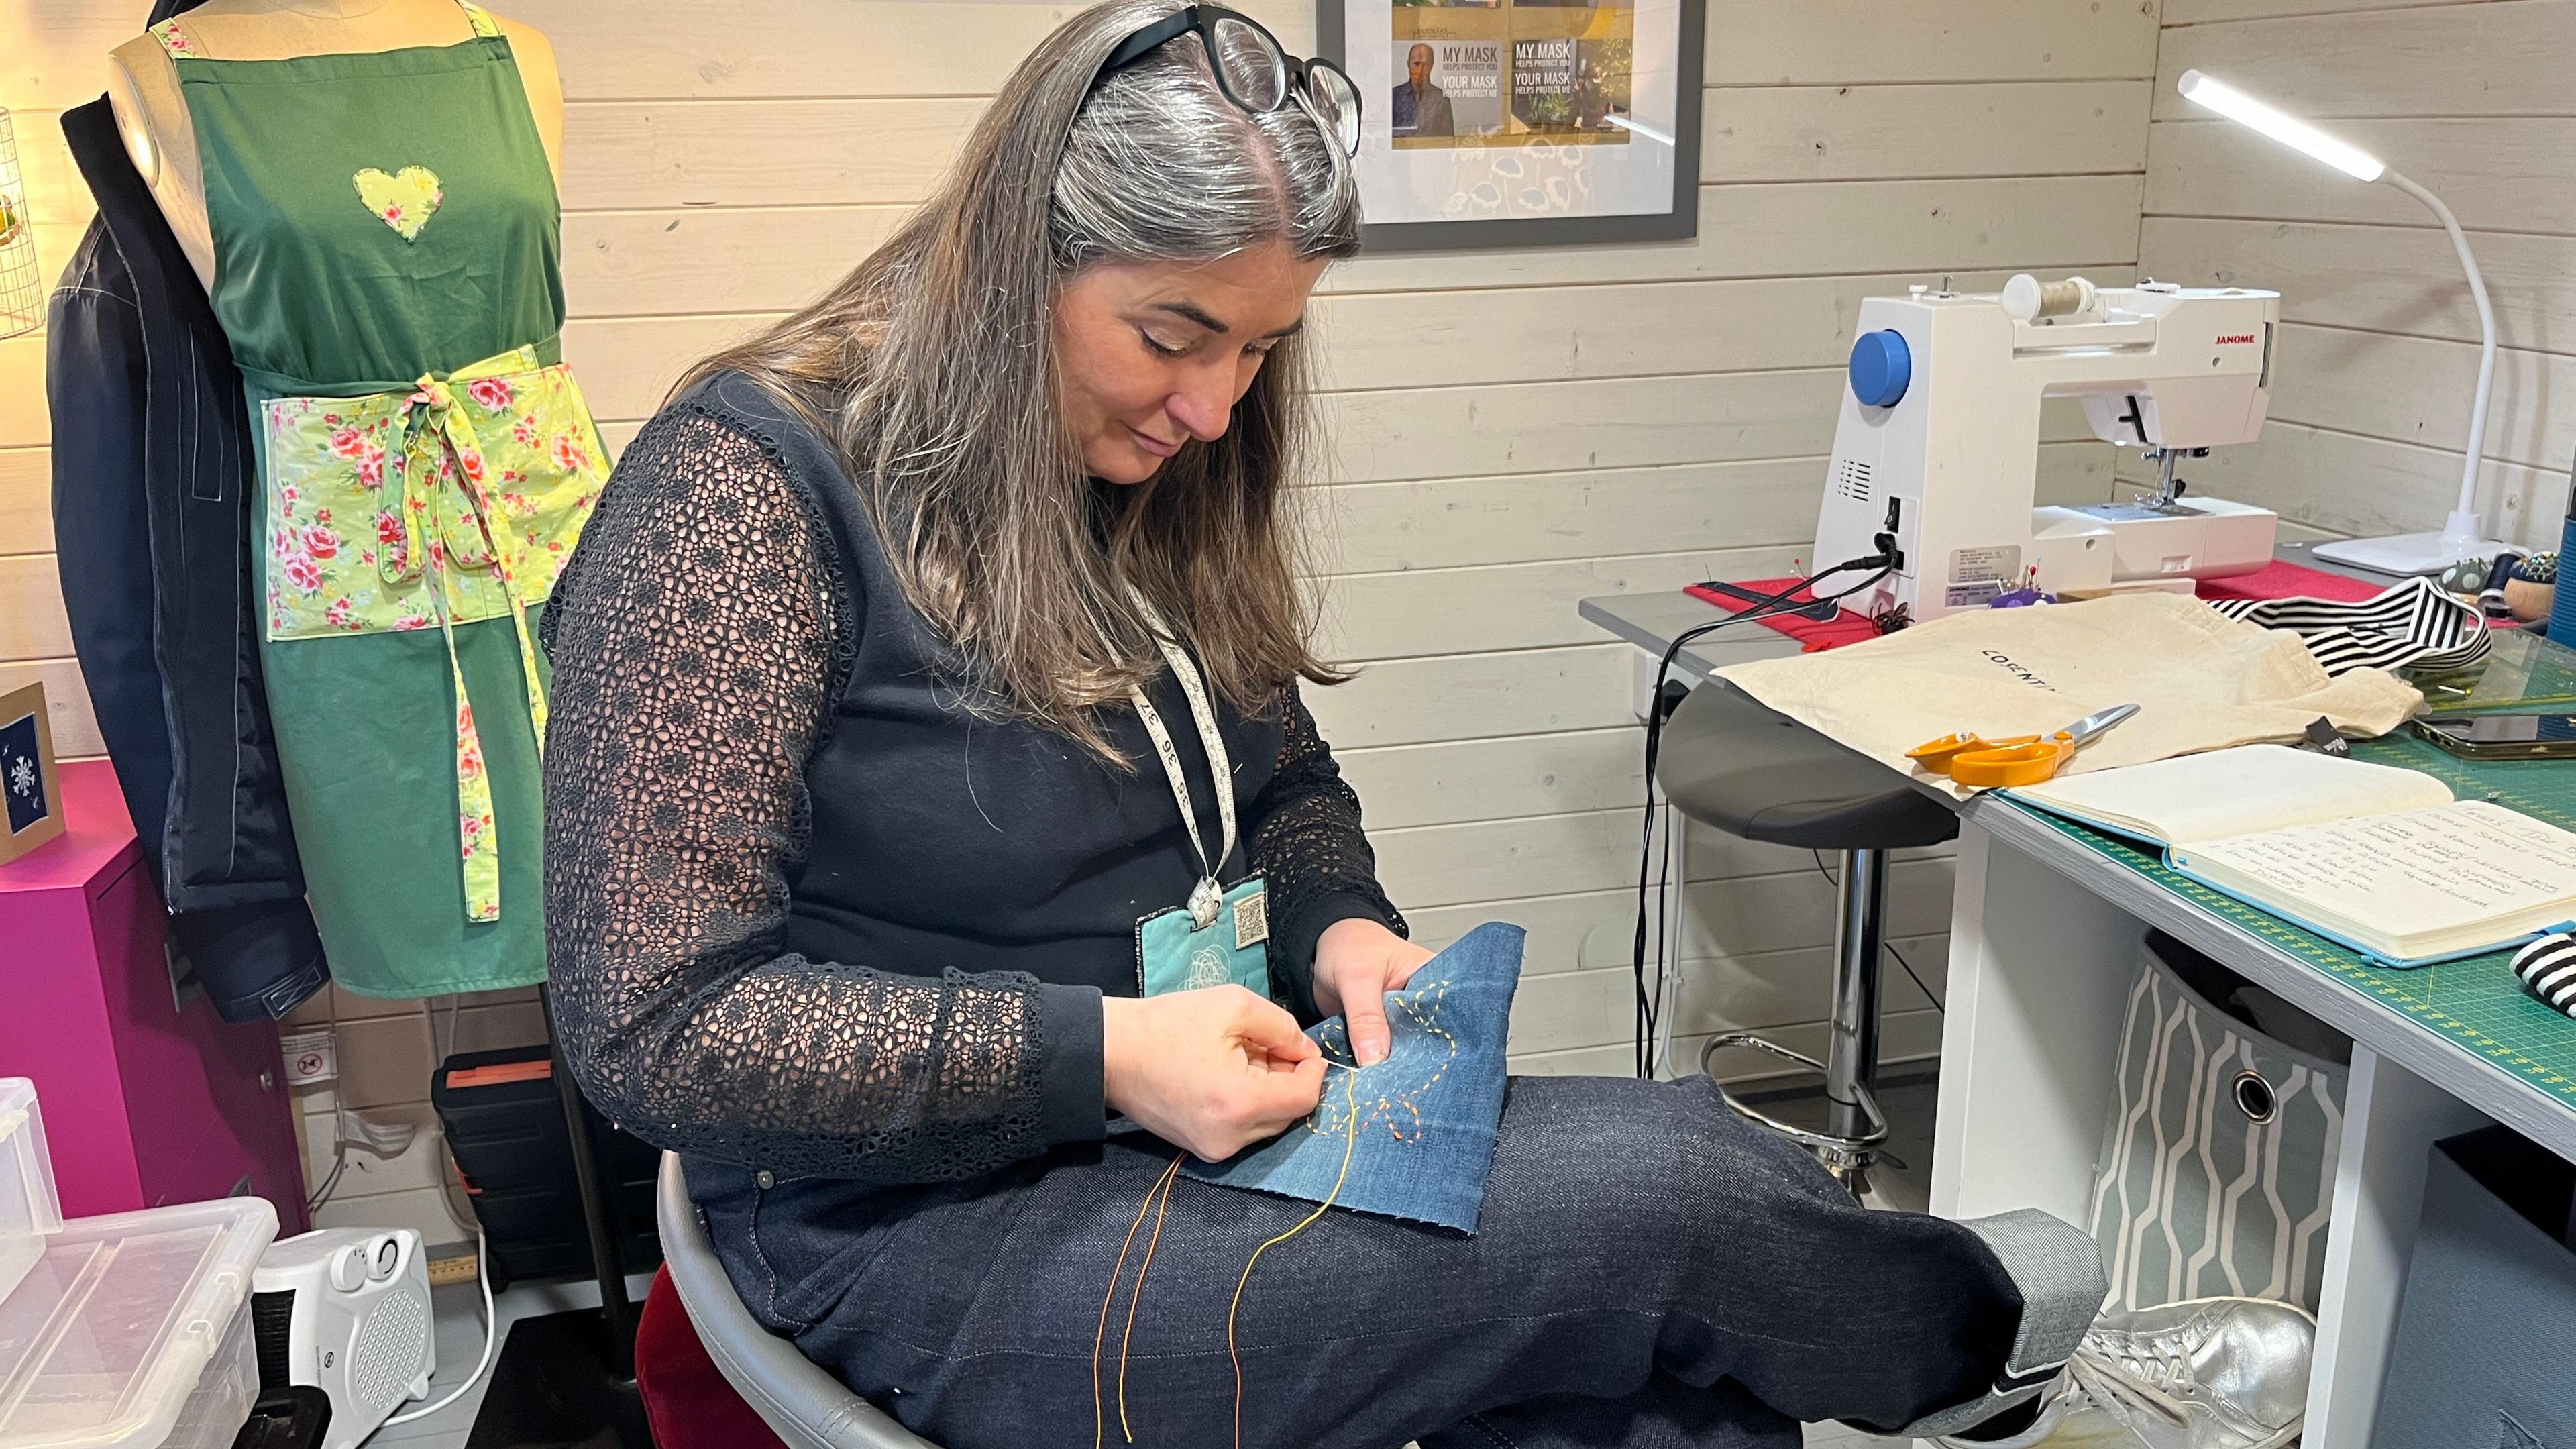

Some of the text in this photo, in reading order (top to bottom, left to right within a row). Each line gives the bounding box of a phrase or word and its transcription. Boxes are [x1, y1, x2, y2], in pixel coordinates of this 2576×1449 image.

[1443, 47, 1497, 62] MY MASK
[1516, 44, 1570, 59] MY MASK
[1534, 59, 1558, 67] PROTECT
[1442, 76, 1497, 89] YOUR MASK
[1515, 72, 1570, 86] YOUR MASK
[1443, 89, 1497, 98] HELPS PROTECT ME
[1516, 85, 1570, 94] HELPS PROTECT ME
[2215, 335, 2255, 345] JANOME
